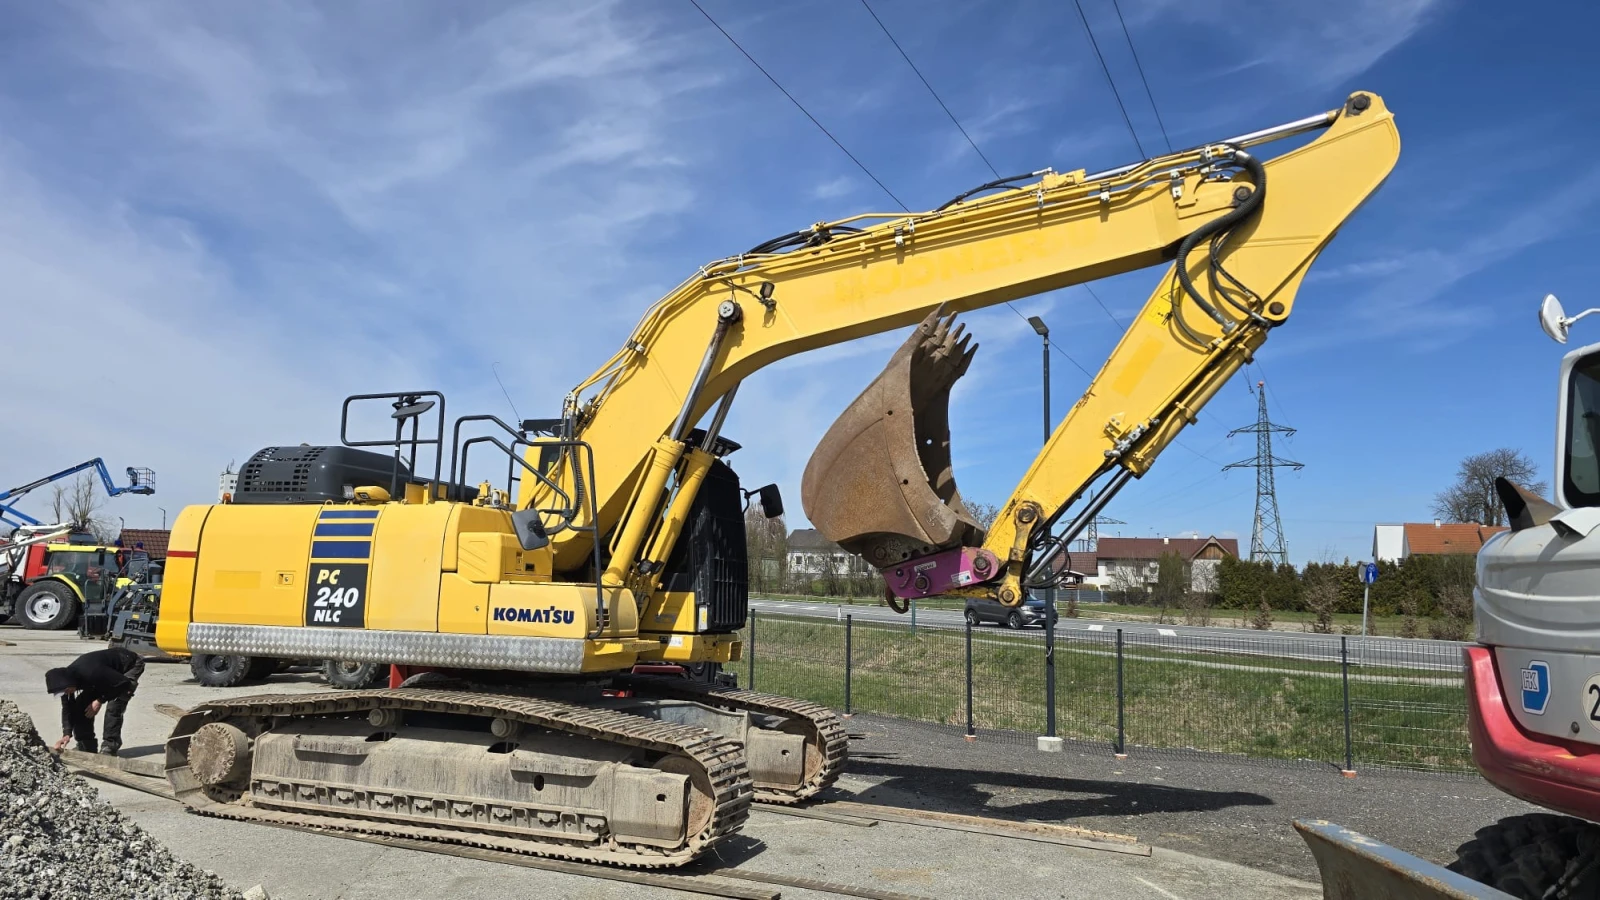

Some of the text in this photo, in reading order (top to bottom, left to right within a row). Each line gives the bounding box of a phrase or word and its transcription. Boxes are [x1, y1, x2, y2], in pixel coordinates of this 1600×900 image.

[316, 569, 341, 585] PC
[313, 586, 359, 608] 240
[313, 609, 342, 623] NLC
[493, 605, 575, 625] KOMATSU
